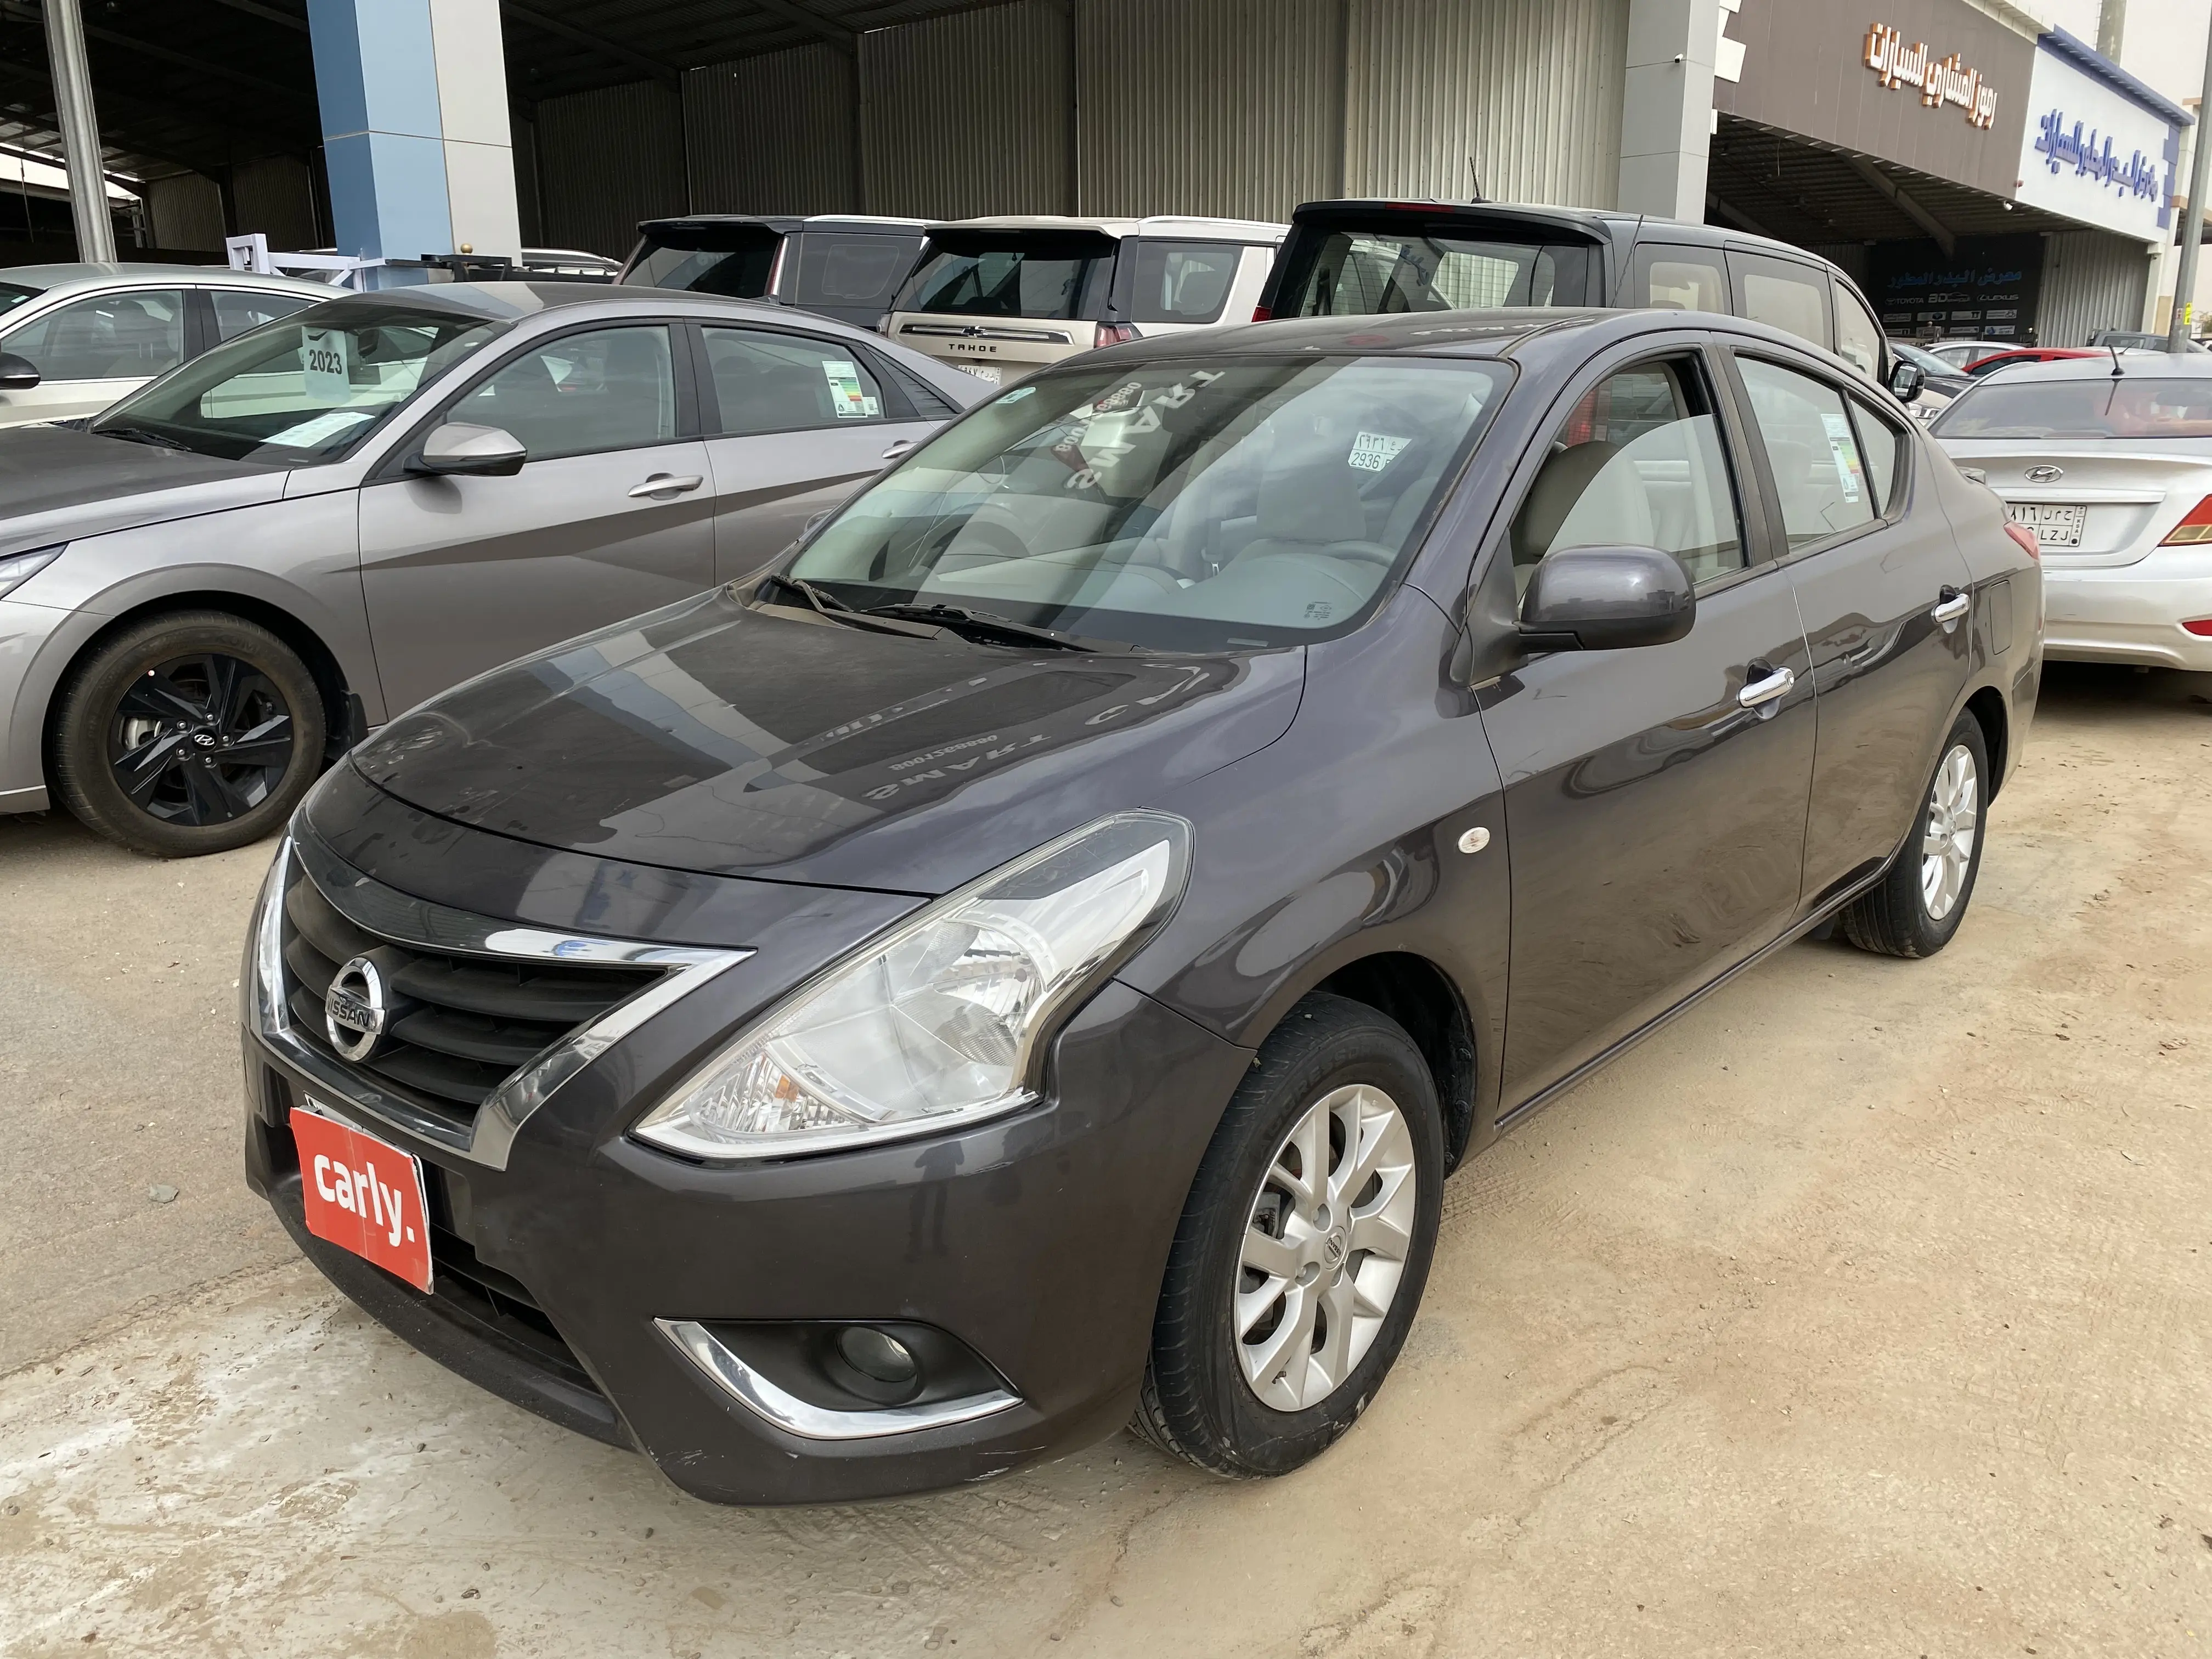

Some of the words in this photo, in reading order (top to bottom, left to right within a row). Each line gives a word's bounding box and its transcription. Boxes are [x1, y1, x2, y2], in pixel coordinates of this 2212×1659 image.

[1865, 22, 1929, 89] للسيارات
[949, 343, 997, 352] TAHOE
[309, 349, 342, 375] 2023
[1350, 452, 1381, 469] 2936
[314, 1153, 415, 1248] carly.
